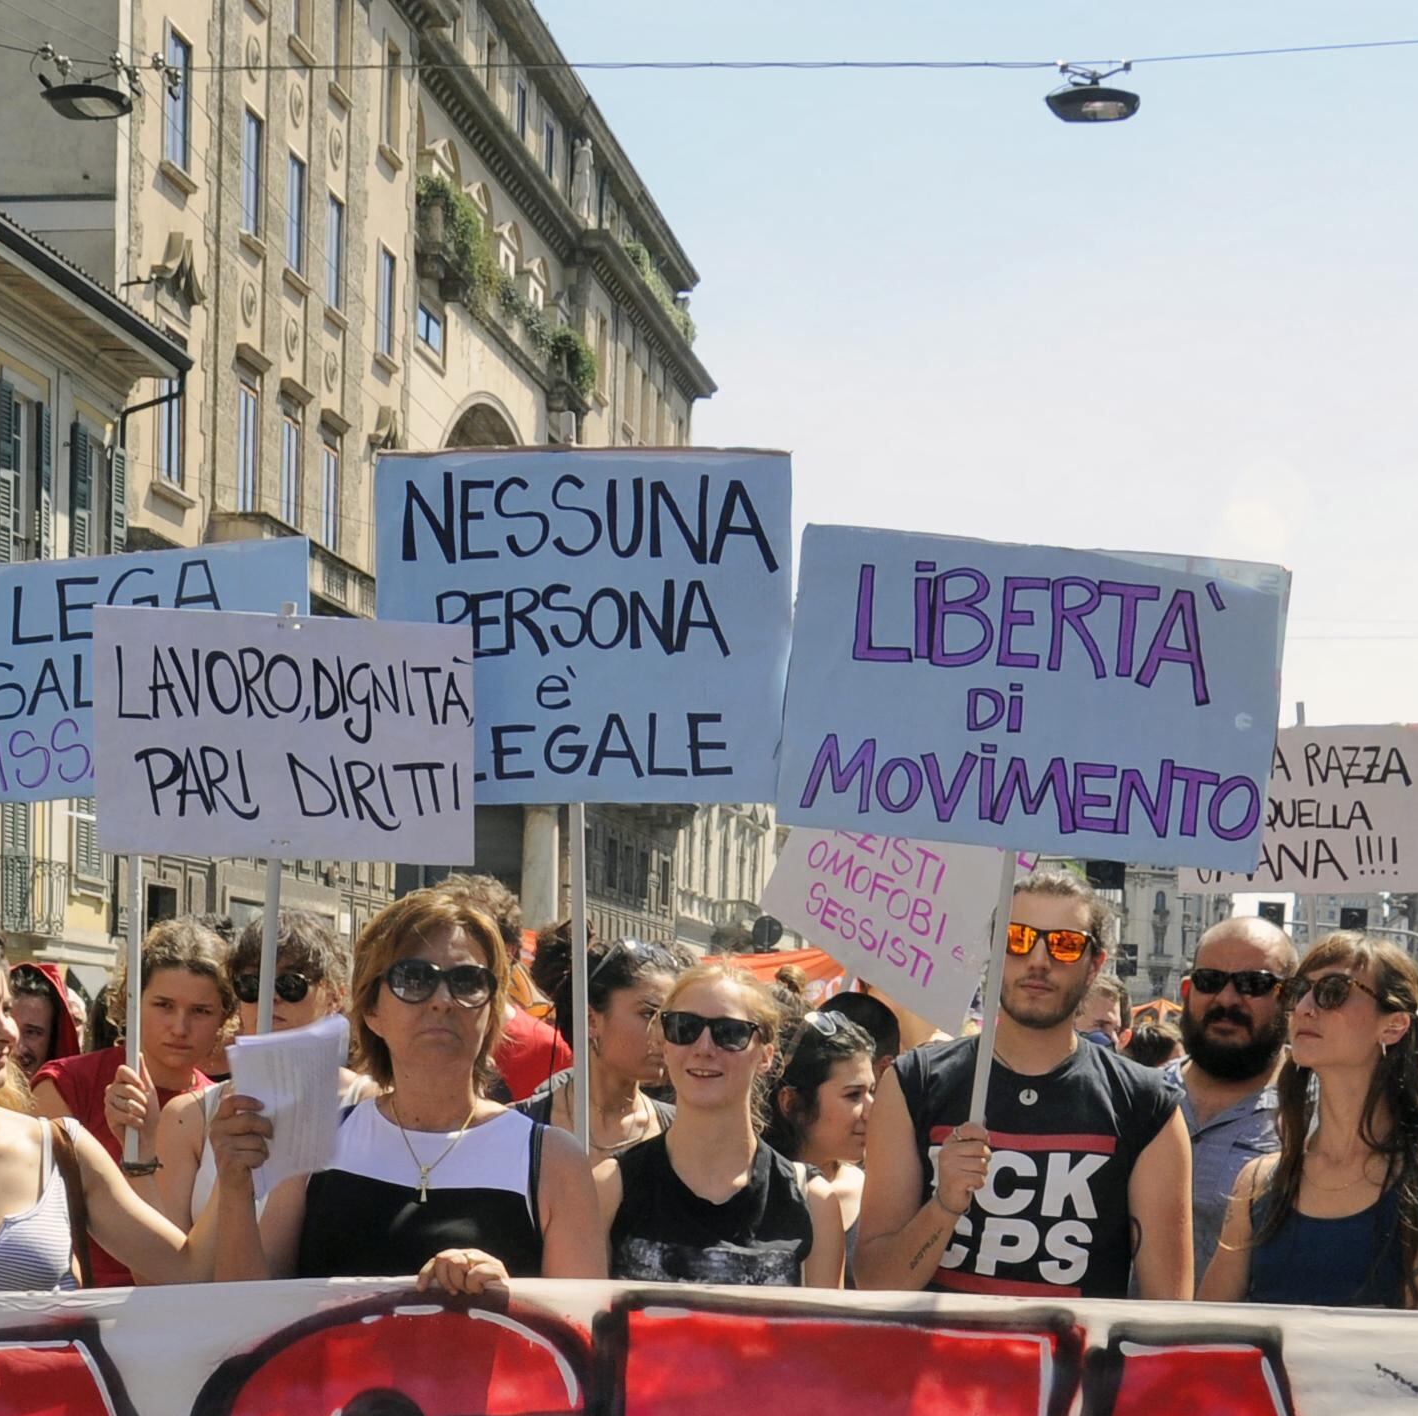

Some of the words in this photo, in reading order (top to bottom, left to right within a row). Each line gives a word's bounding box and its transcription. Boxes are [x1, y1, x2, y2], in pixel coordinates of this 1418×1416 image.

[401, 471, 780, 574] NESSUNA
[434, 578, 731, 659] PERSONA
[134, 745, 260, 821] PARI
[285, 751, 461, 832] DIRITTI
[474, 711, 734, 783] EGALE
[1303, 742, 1413, 789] RAZZA
[805, 881, 935, 988] SESSISTI
[807, 840, 948, 945] OMOFOBI
